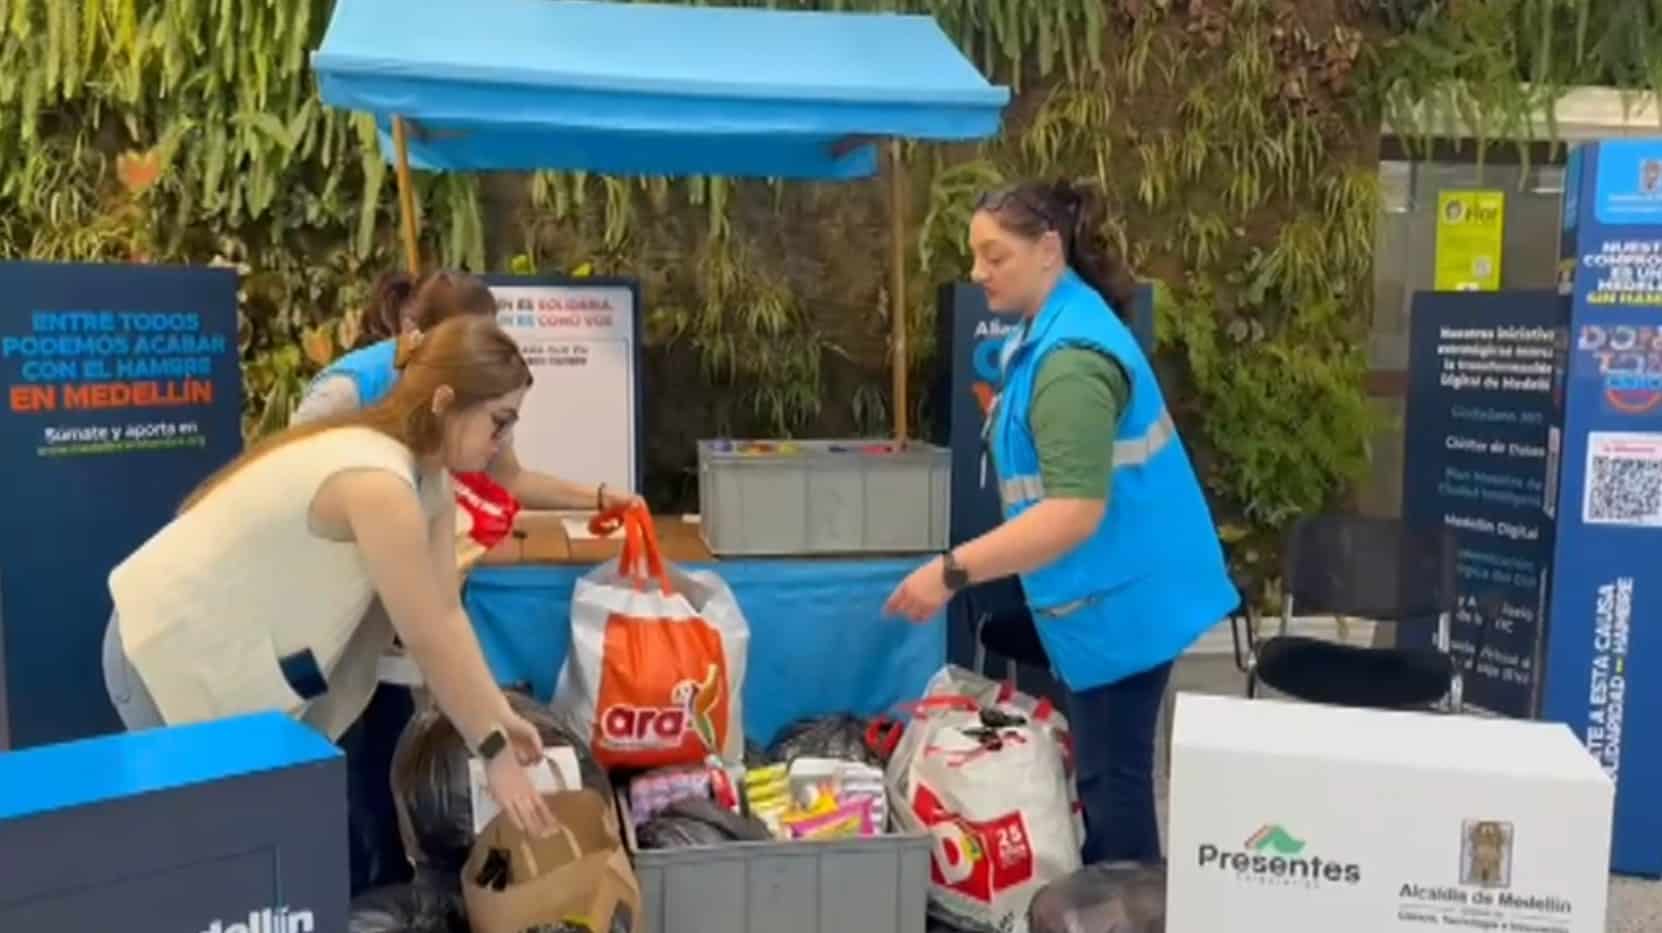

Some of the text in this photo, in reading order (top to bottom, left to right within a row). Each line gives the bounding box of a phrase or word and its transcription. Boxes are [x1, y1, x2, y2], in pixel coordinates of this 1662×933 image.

[32, 311, 201, 332] ENTRE TODOS
[2, 334, 226, 357] PODEMOS ACABAR
[22, 357, 212, 381] CON EL HAMBRE
[9, 377, 213, 413] EN MEDELLÍN
[44, 422, 198, 443] Súmate y aporta en
[1497, 521, 1539, 540] Digital
[1594, 584, 1616, 652] CAUSA
[1589, 655, 1611, 705] ESTA
[604, 705, 687, 744] ara
[1197, 843, 1361, 884] Presentes
[1471, 890, 1494, 905] de
